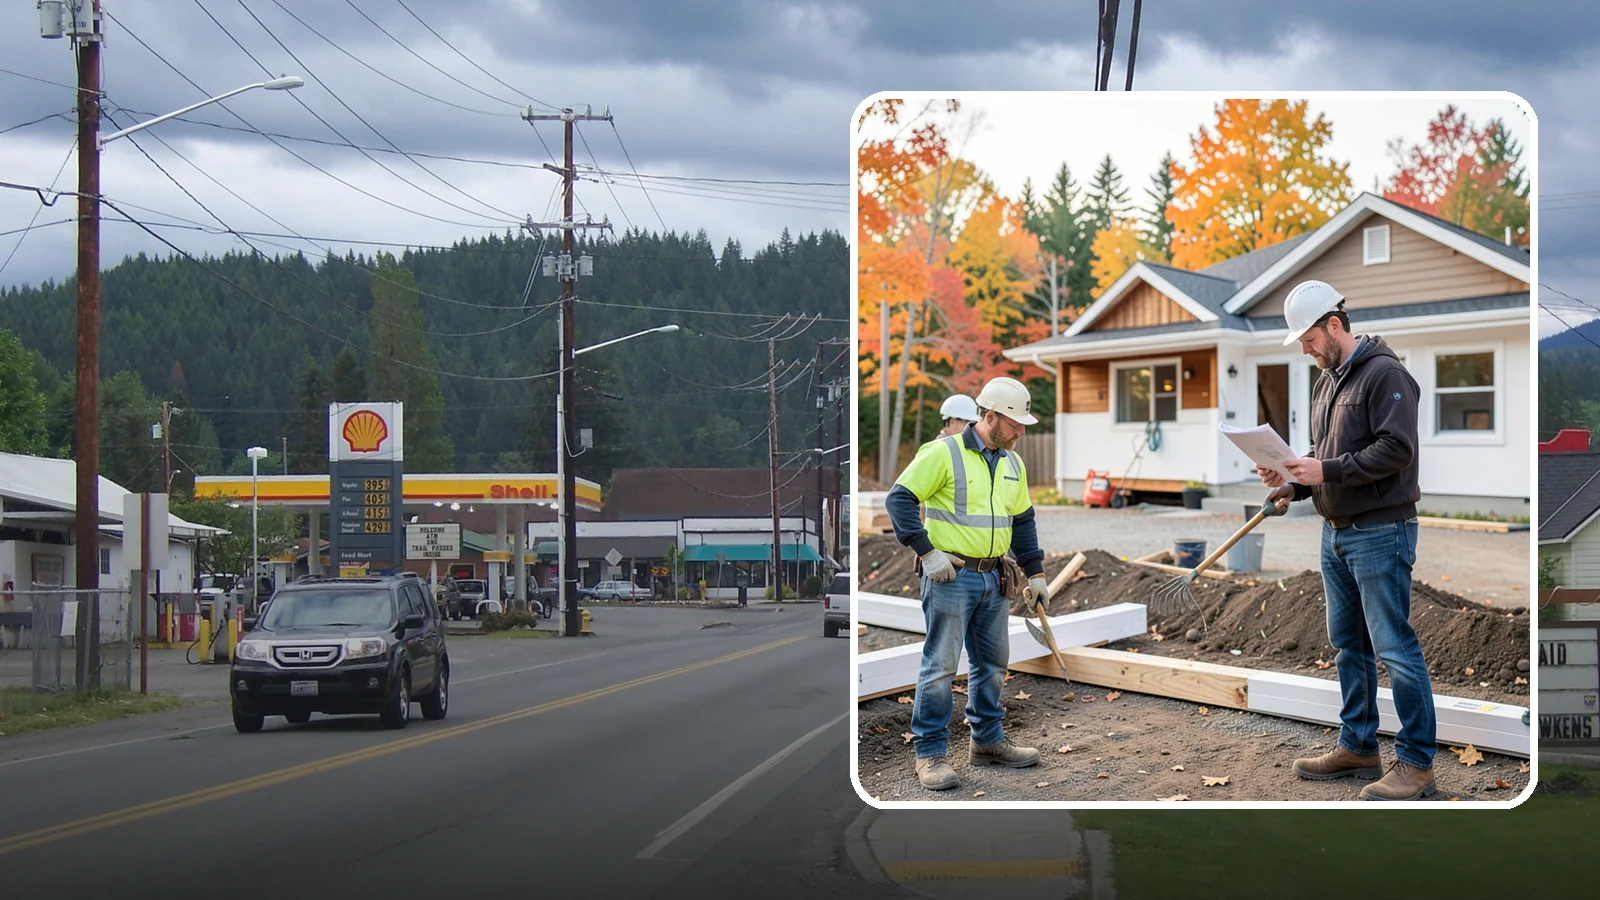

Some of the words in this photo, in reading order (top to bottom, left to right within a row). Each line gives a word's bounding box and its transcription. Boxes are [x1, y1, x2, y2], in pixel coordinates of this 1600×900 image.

[366, 480, 383, 490] 395
[490, 484, 547, 499] Shell
[366, 494, 383, 504] 405
[366, 508, 383, 518] 415
[366, 522, 383, 533] 429
[1538, 643, 1566, 665] AID
